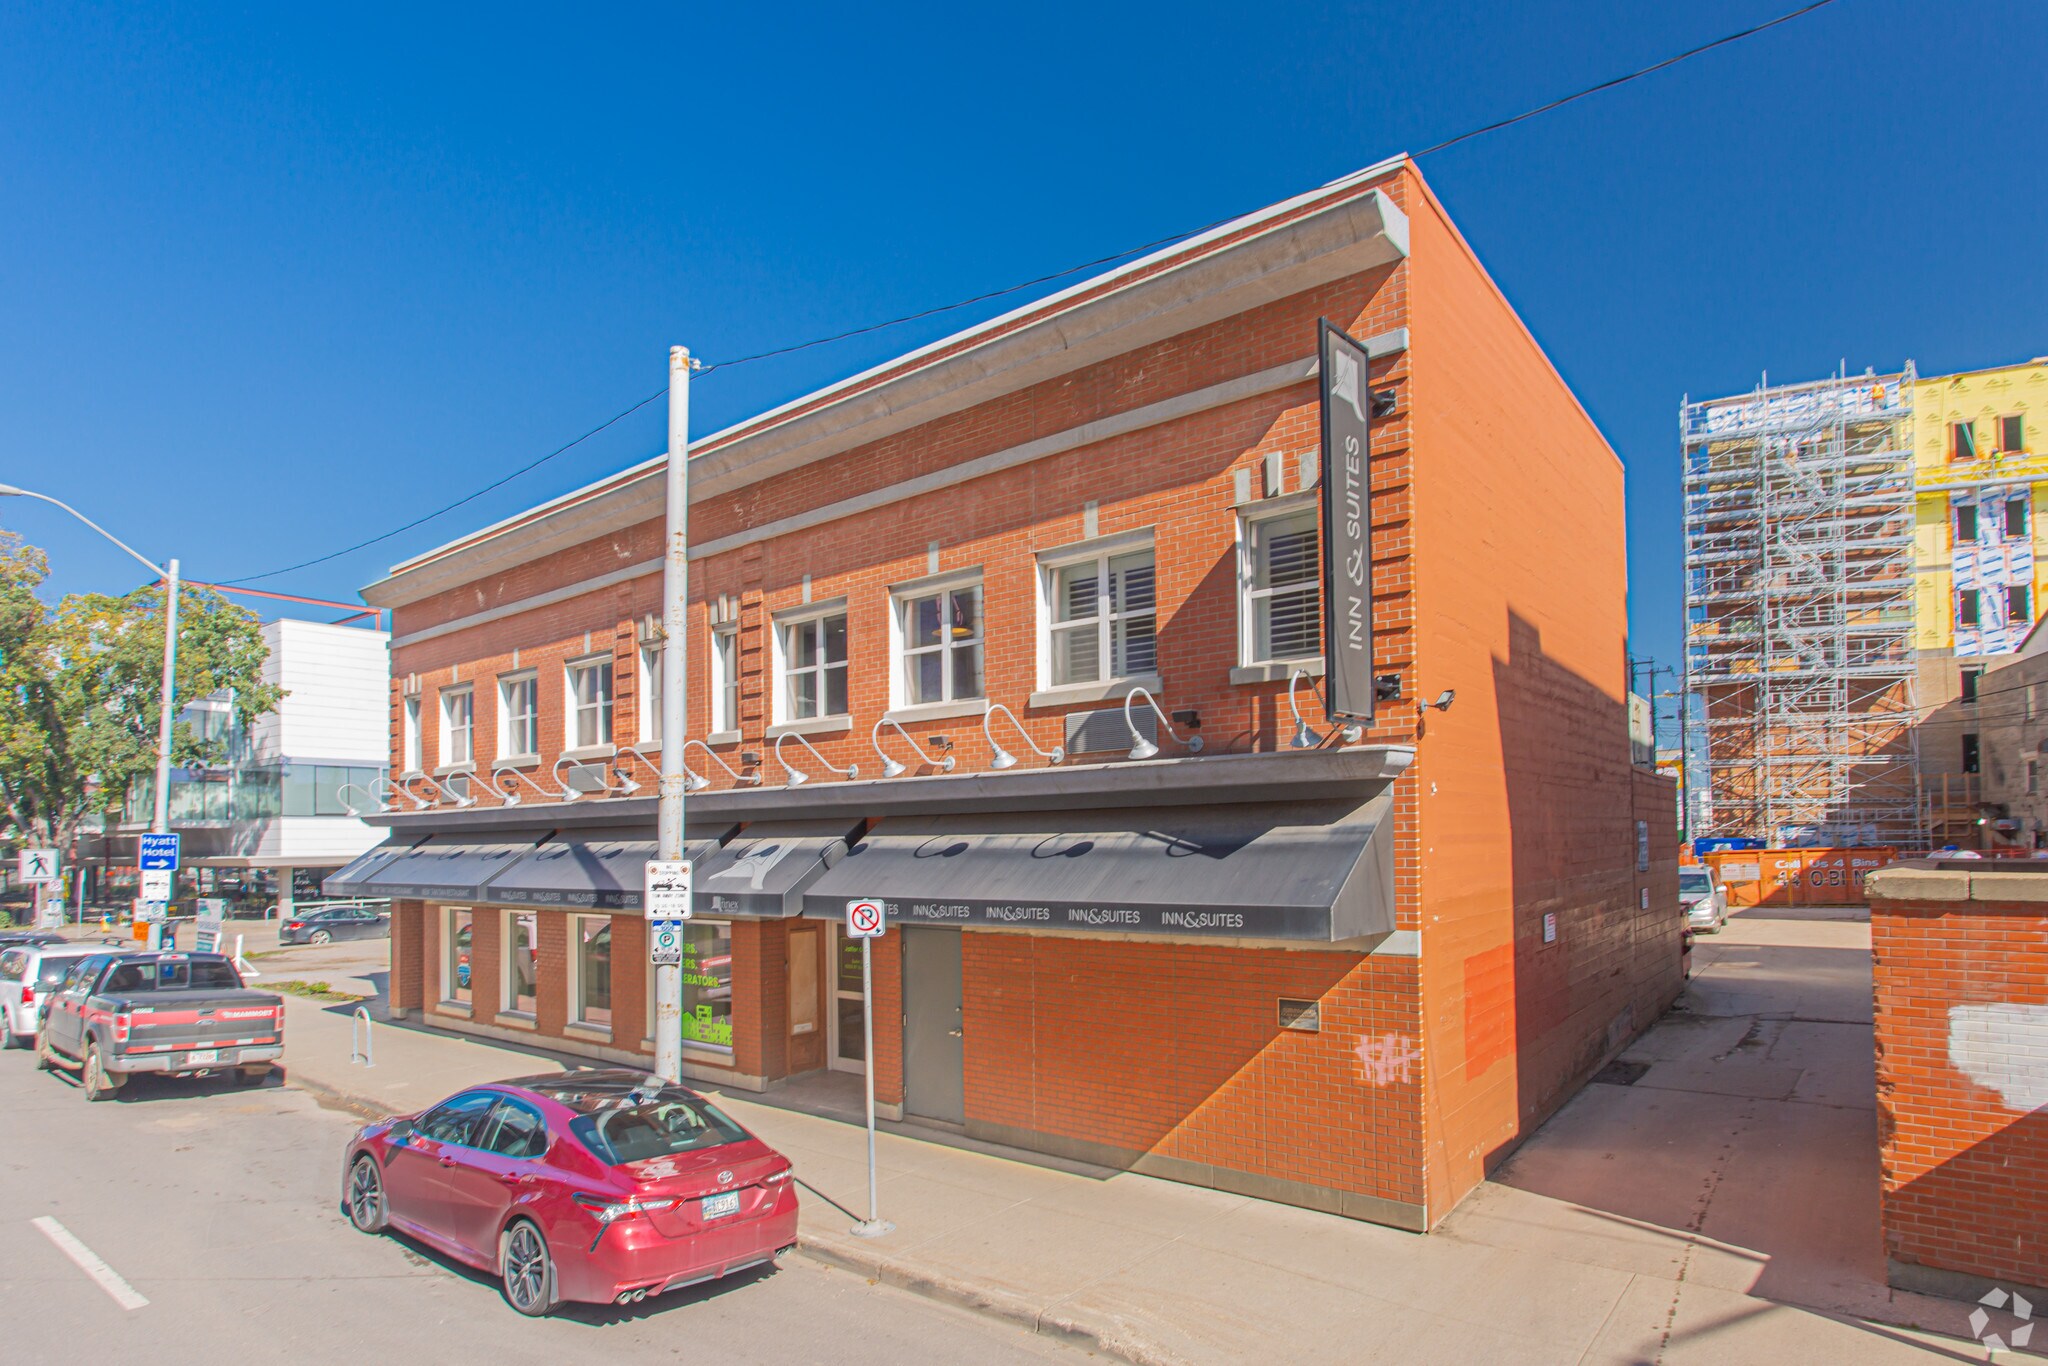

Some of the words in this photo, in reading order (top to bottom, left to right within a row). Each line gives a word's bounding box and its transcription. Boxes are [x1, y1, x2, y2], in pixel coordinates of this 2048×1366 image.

[1345, 435, 1361, 540] SUITES
[1346, 542, 1364, 586] &
[1348, 596, 1363, 650] INN
[143, 836, 177, 847] Hyatt
[143, 847, 176, 857] Hotel
[1774, 859, 1801, 869] Call
[1809, 859, 1829, 868] Us
[1833, 859, 1845, 867] 4
[1851, 858, 1880, 867] Bins
